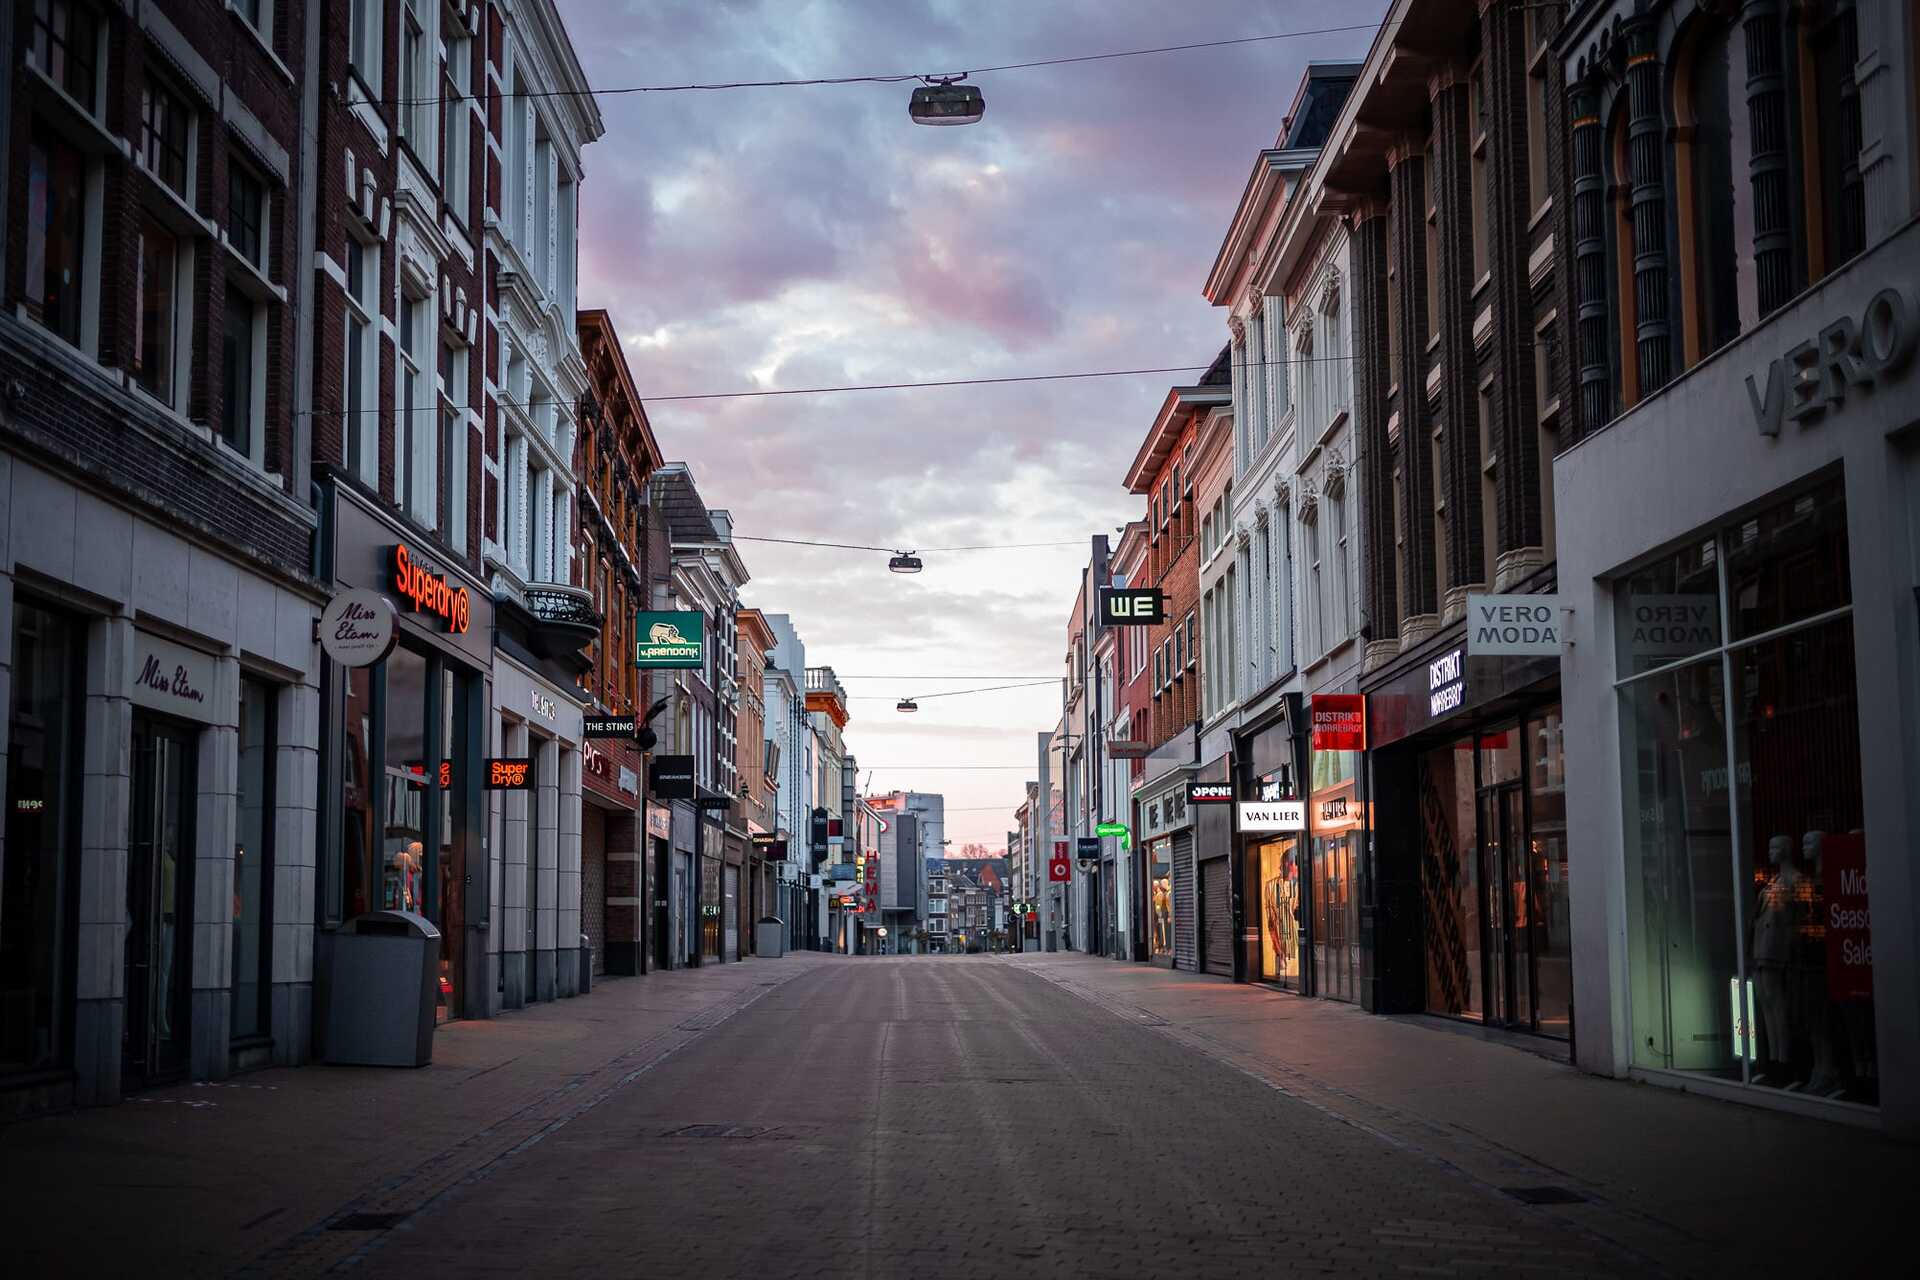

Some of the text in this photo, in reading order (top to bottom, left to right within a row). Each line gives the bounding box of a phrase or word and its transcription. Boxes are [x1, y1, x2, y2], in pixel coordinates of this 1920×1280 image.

[1744, 288, 1905, 437] VERO
[336, 602, 376, 622] Miss
[1110, 597, 1152, 617] WE
[1480, 606, 1551, 623] VERO
[334, 621, 379, 640] Etam
[1476, 627, 1557, 643] MODA
[135, 654, 204, 703] Miss Etam
[1429, 650, 1460, 690] DISTRIKT
[586, 723, 634, 731] THE STING
[492, 763, 528, 776] Super
[1246, 811, 1300, 821] VAN LIER
[866, 850, 878, 912] HEMA
[1842, 939, 1871, 966] Sale
